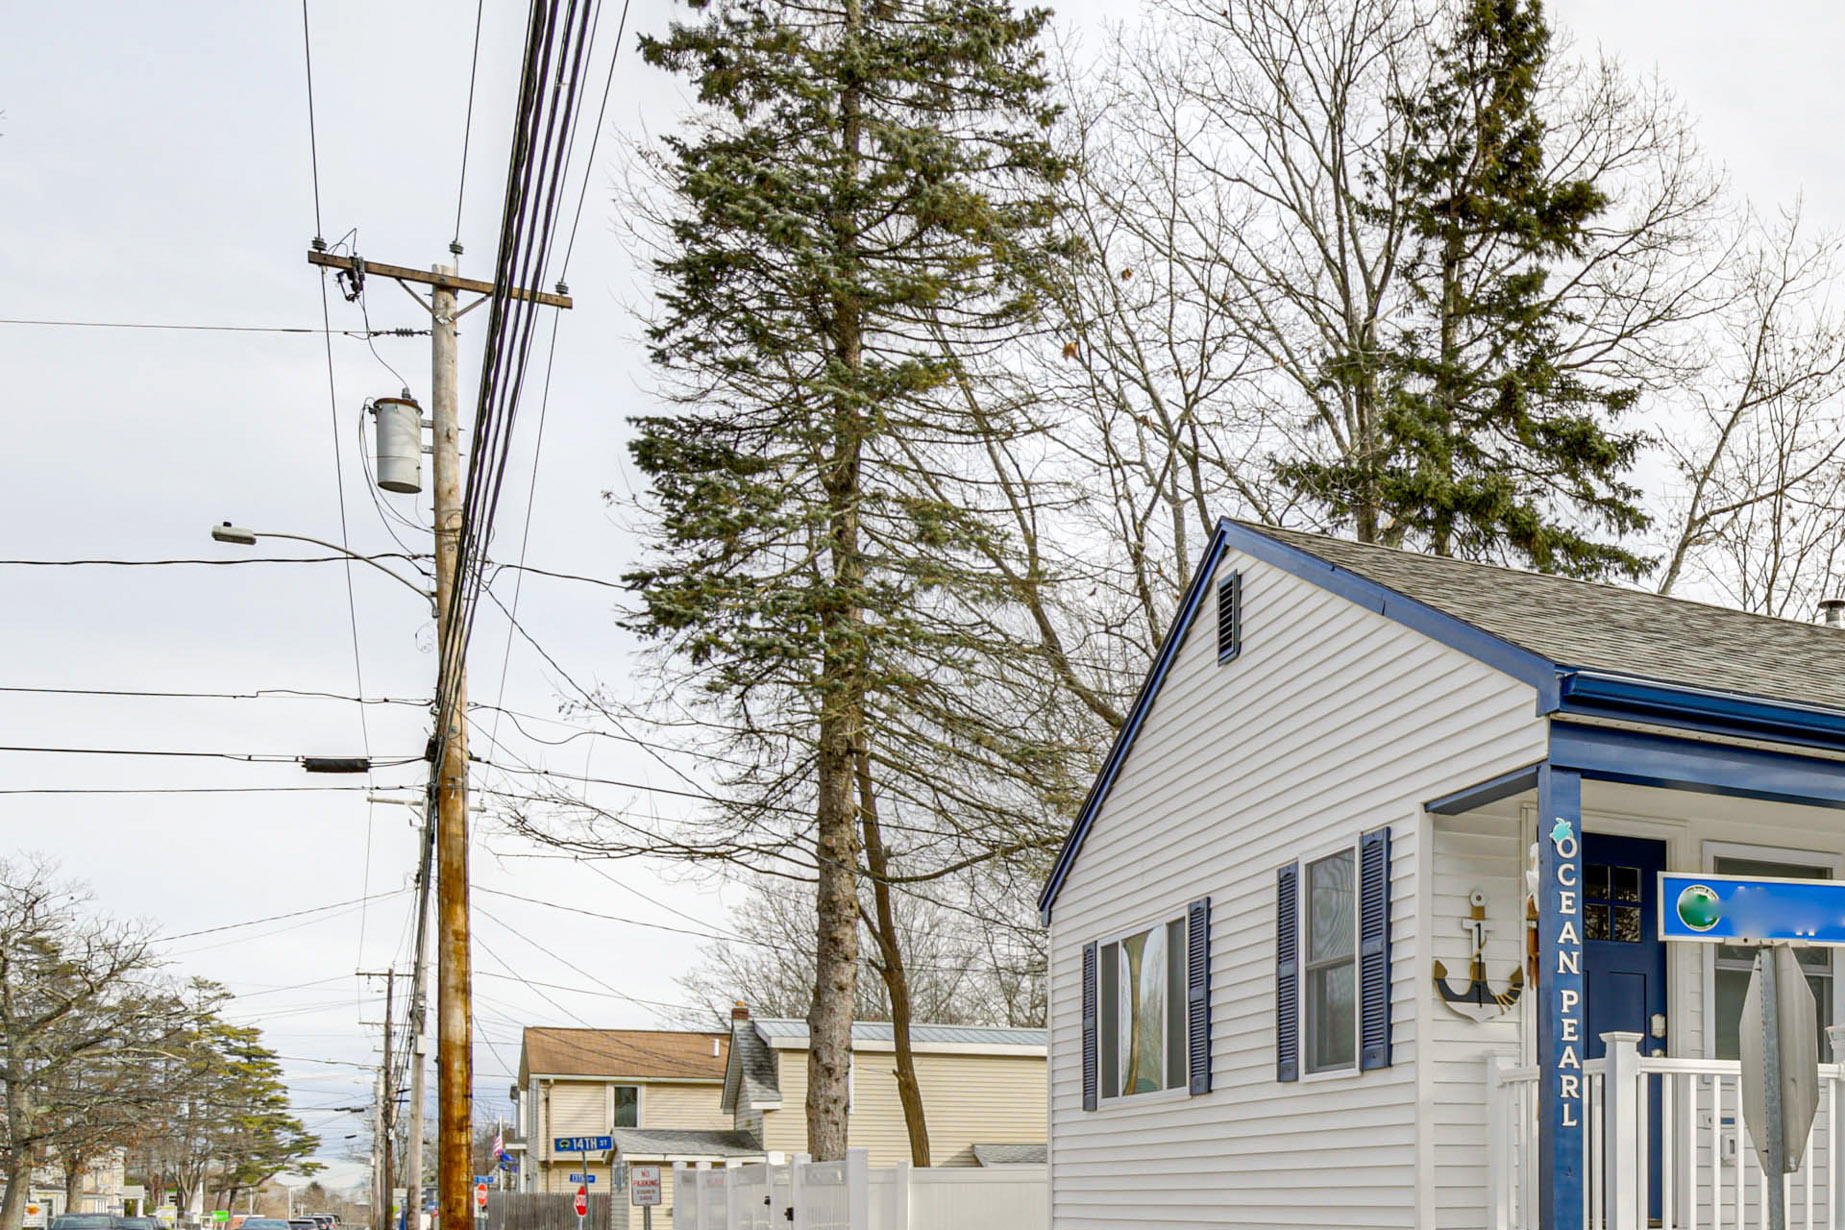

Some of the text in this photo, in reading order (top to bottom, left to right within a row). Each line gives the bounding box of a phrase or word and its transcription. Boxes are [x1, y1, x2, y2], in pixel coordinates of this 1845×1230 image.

[1557, 837, 1581, 1127] OCEAN PEARL
[573, 1138, 597, 1150] 14TH
